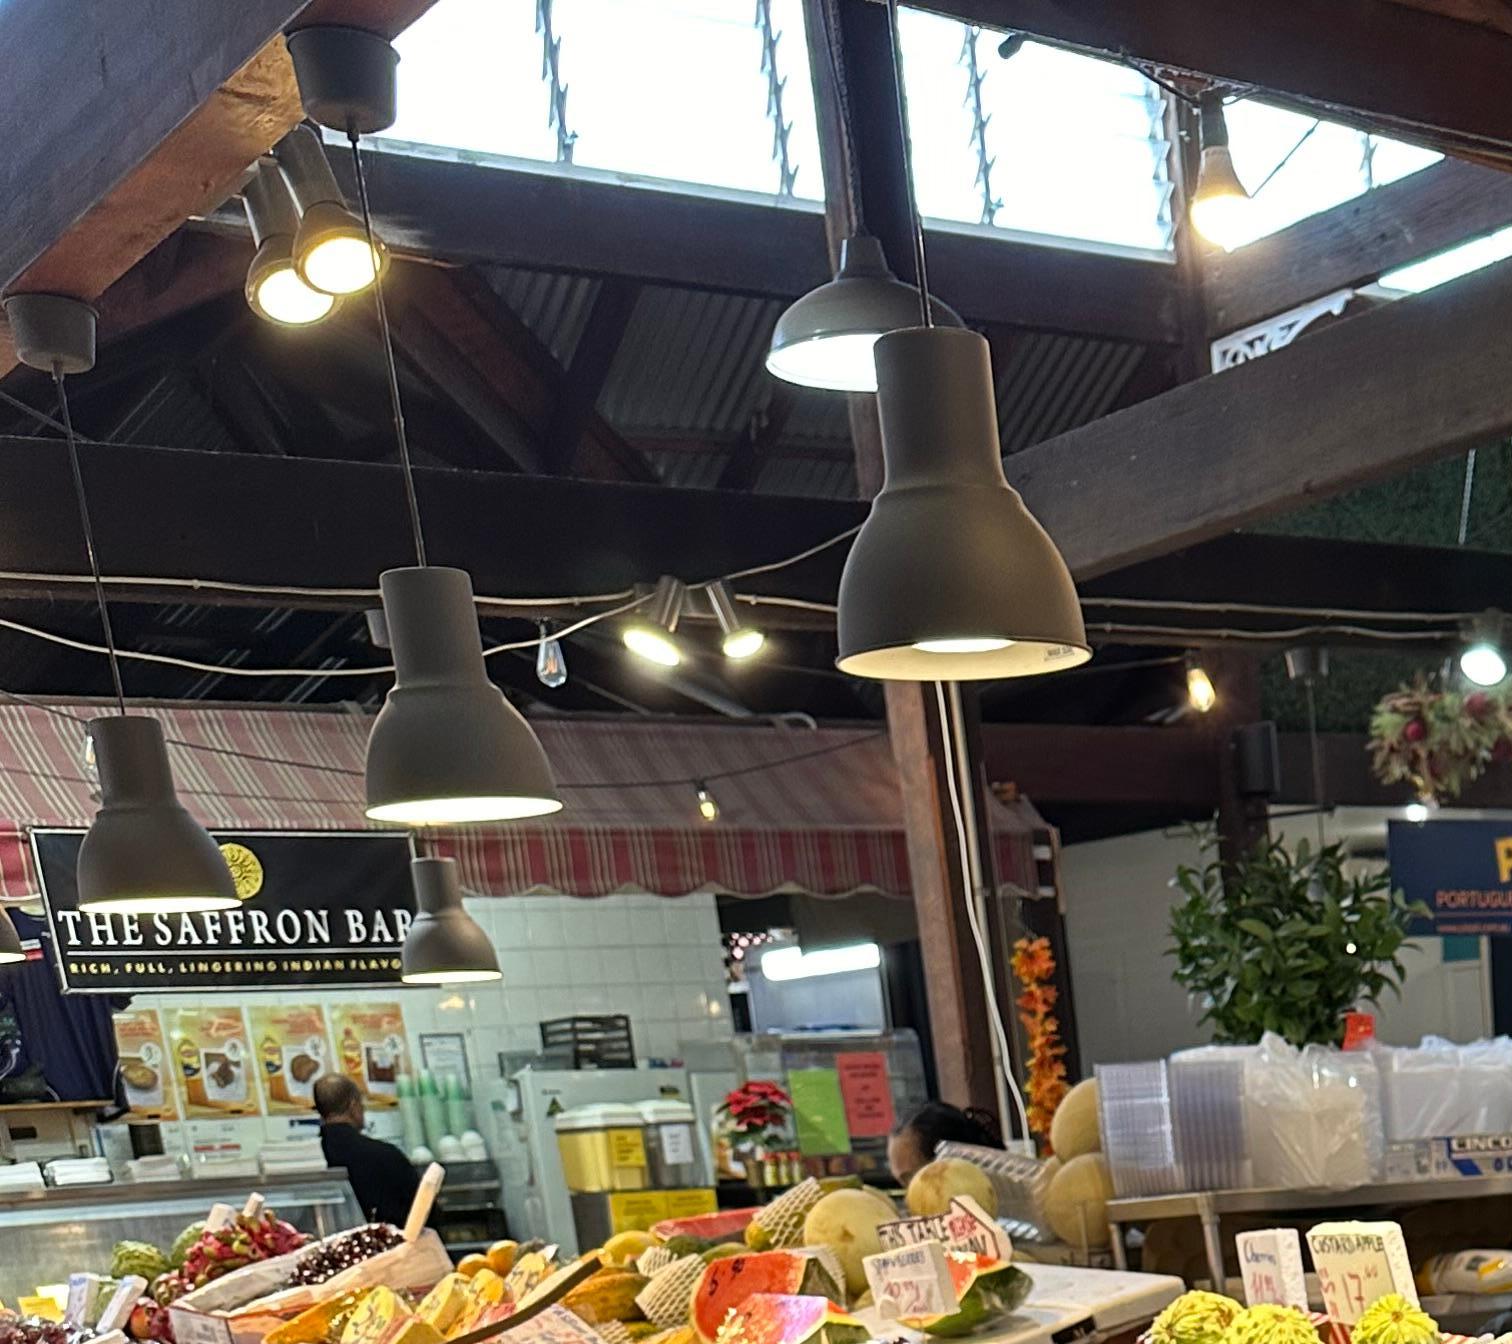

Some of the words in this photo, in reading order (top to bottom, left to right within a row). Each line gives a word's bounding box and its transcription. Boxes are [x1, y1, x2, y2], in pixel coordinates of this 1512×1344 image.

[57, 909, 144, 946] THE
[152, 908, 332, 947] SAFFRON
[69, 961, 119, 976] RICH,
[178, 960, 278, 975] LINGERING
[282, 958, 346, 973] INDIAN
[350, 958, 402, 972] FLAVO
